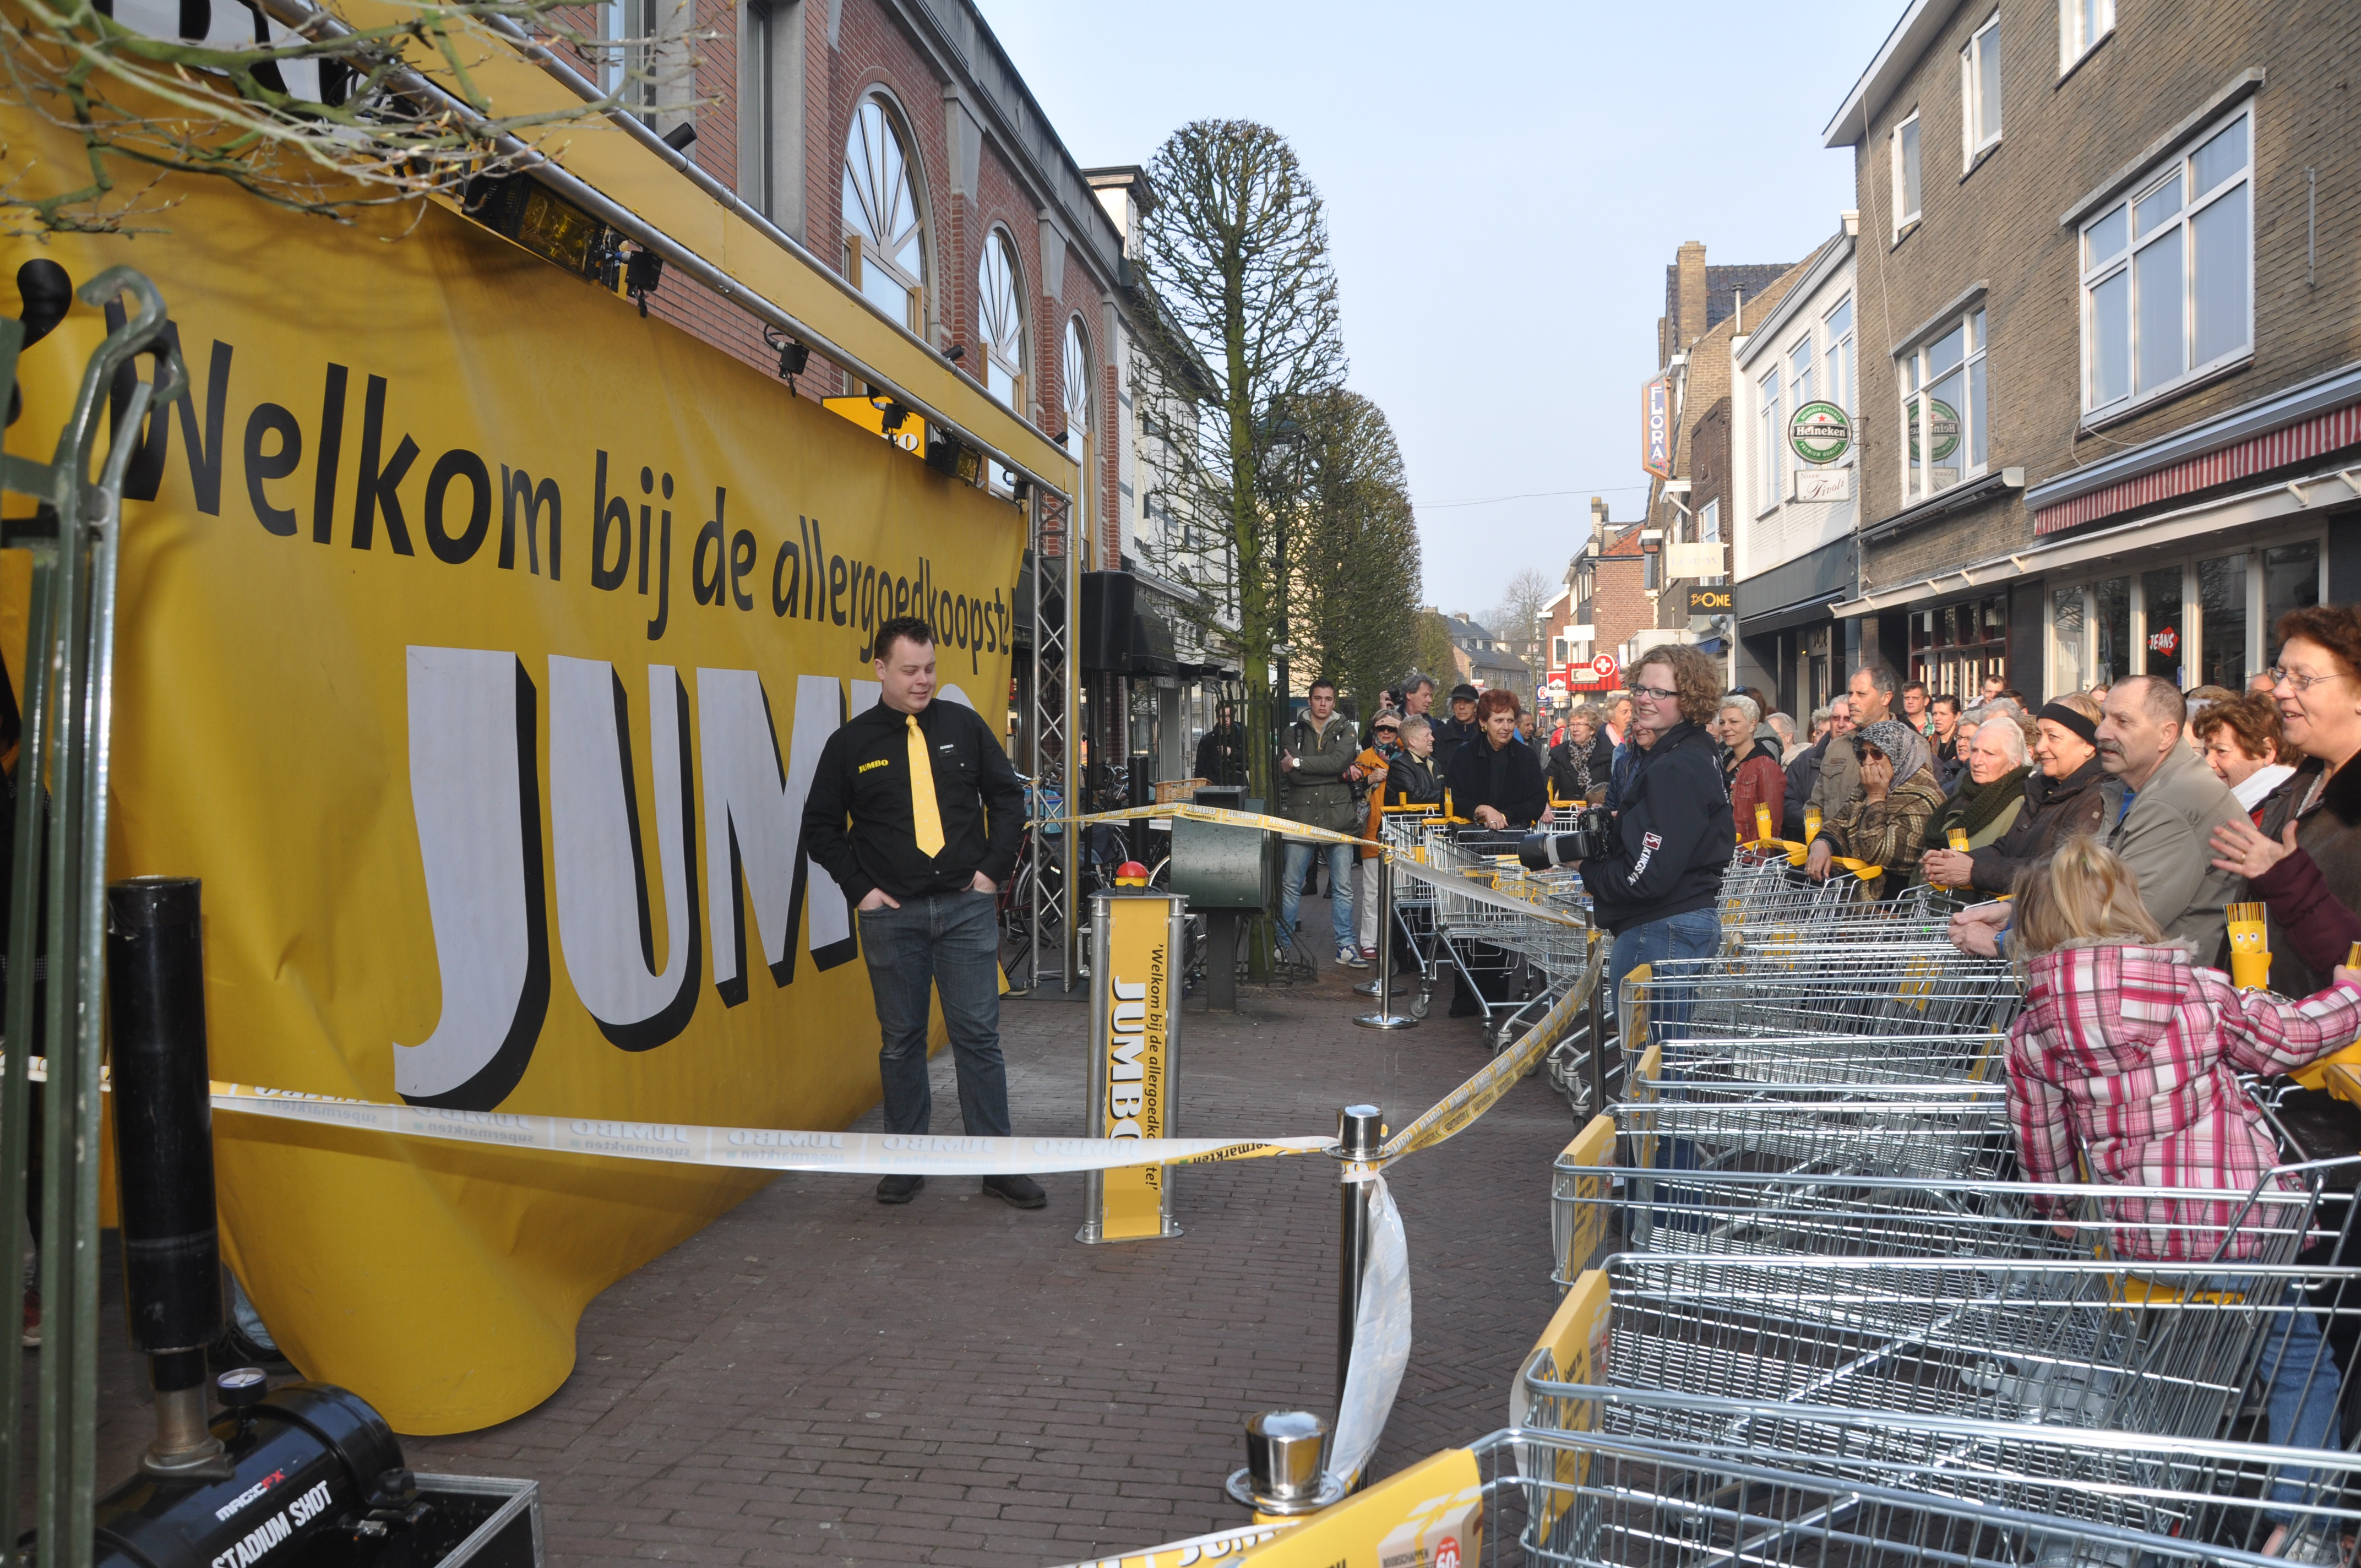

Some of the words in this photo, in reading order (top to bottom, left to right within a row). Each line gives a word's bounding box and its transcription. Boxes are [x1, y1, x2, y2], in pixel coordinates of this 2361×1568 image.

[1801, 407, 1822, 420] HEINEKEN
[1823, 407, 1842, 421] PILSENER
[1650, 386, 1664, 459] FLORA
[1796, 426, 1846, 437] Heineken
[1799, 443, 1821, 457] PREMIUM
[1823, 444, 1842, 456] QUALITY
[1803, 477, 1845, 499] Tivoli
[591, 449, 673, 640] bij
[693, 487, 757, 611] de
[1702, 592, 1732, 607] ONE
[2149, 633, 2174, 650] JEANS
[858, 759, 889, 773] JUMBO
[1186, 805, 1216, 815] JUMBO
[1226, 811, 1259, 820] JUMBO
[1268, 818, 1300, 830] JUMBO
[391, 644, 988, 1111] JUM
[1146, 1012, 1162, 1032] bij
[1149, 1035, 1162, 1053] de
[289, 1480, 332, 1527] SHOT
